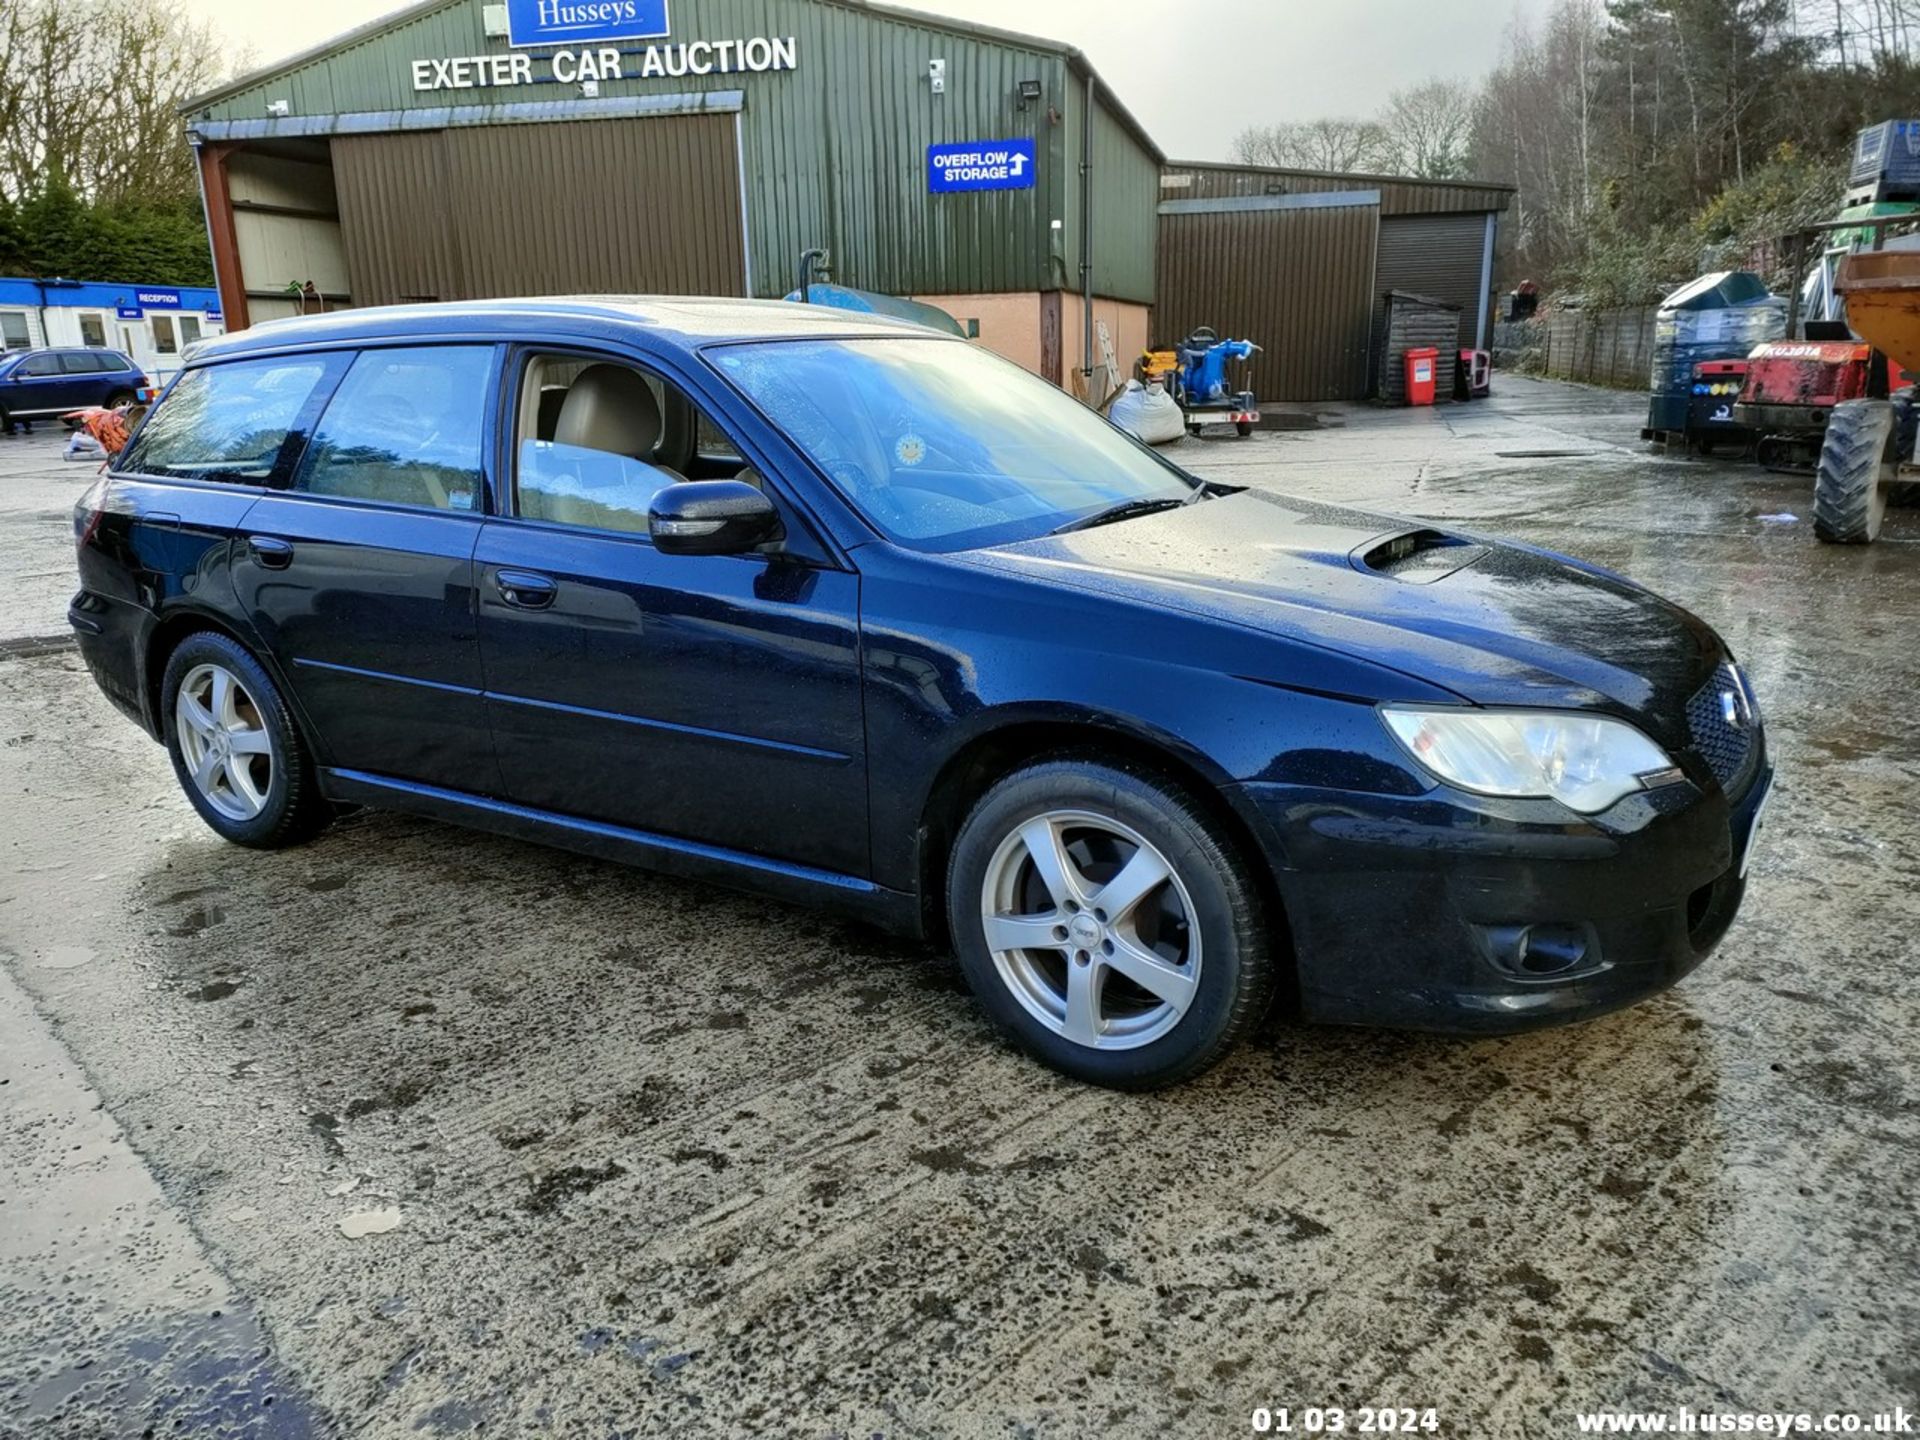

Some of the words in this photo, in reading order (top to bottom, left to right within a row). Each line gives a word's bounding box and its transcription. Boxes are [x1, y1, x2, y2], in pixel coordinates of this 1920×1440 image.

[538, 0, 636, 26] Husseys
[411, 53, 533, 91] EXETER
[553, 48, 622, 83] CAR
[642, 37, 797, 77] AUCTION
[933, 152, 1008, 168] OVERFLOW
[944, 166, 1008, 182] STORAGE
[139, 293, 178, 303] RECEPTION
